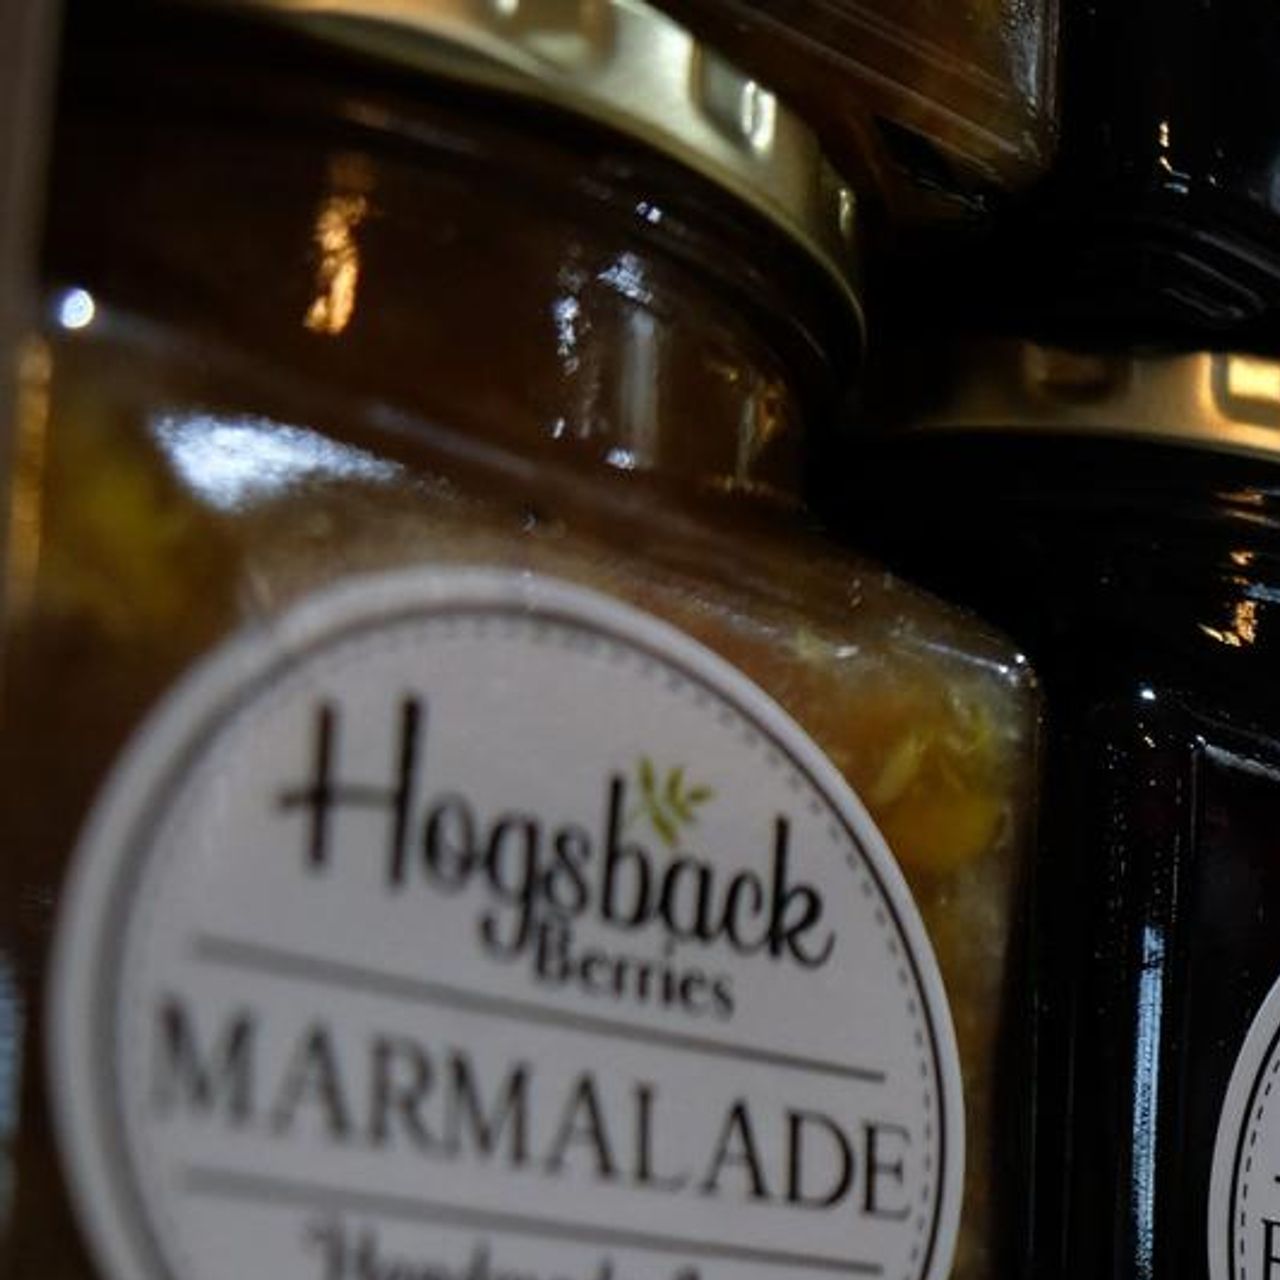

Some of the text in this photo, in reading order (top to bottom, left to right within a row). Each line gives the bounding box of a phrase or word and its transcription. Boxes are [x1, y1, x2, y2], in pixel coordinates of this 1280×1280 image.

[278, 697, 838, 970] Hogsback
[531, 912, 736, 1022] Berries
[150, 988, 914, 1223] MARMALADE
